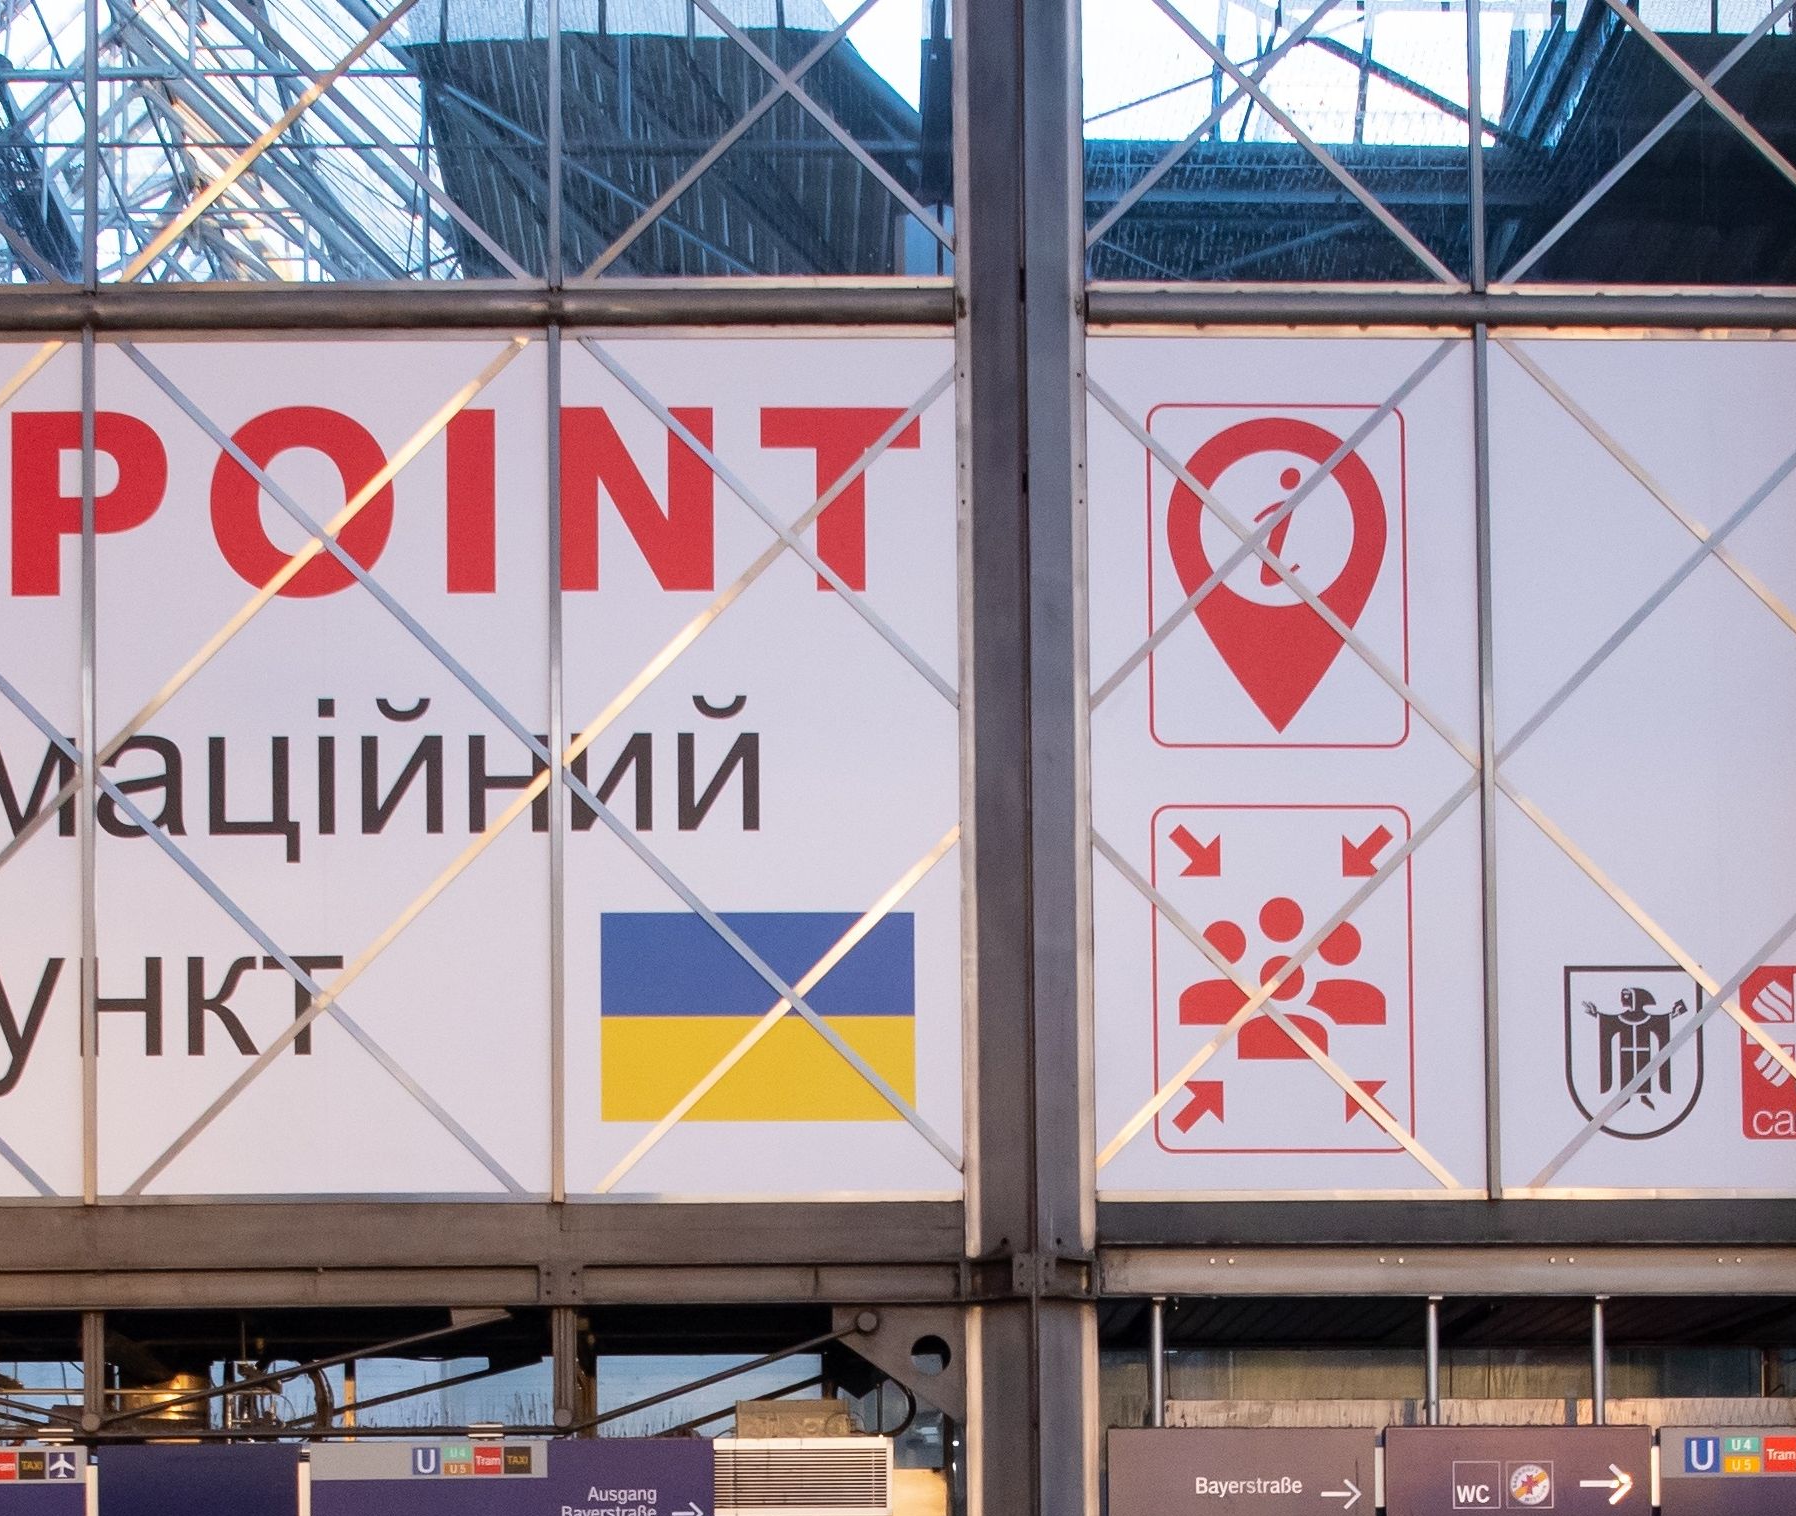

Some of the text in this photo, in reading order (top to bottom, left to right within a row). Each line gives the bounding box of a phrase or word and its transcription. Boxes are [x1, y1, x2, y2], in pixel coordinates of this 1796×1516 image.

[475, 1454, 502, 1467] Tram
[506, 1455, 529, 1466] TAXI
[1766, 1448, 1796, 1461] Tram
[21, 1461, 44, 1471] TAXI
[1194, 1475, 1304, 1499] Bayerstraße
[587, 1486, 657, 1505] Ausgang
[1456, 1484, 1491, 1504] WC
